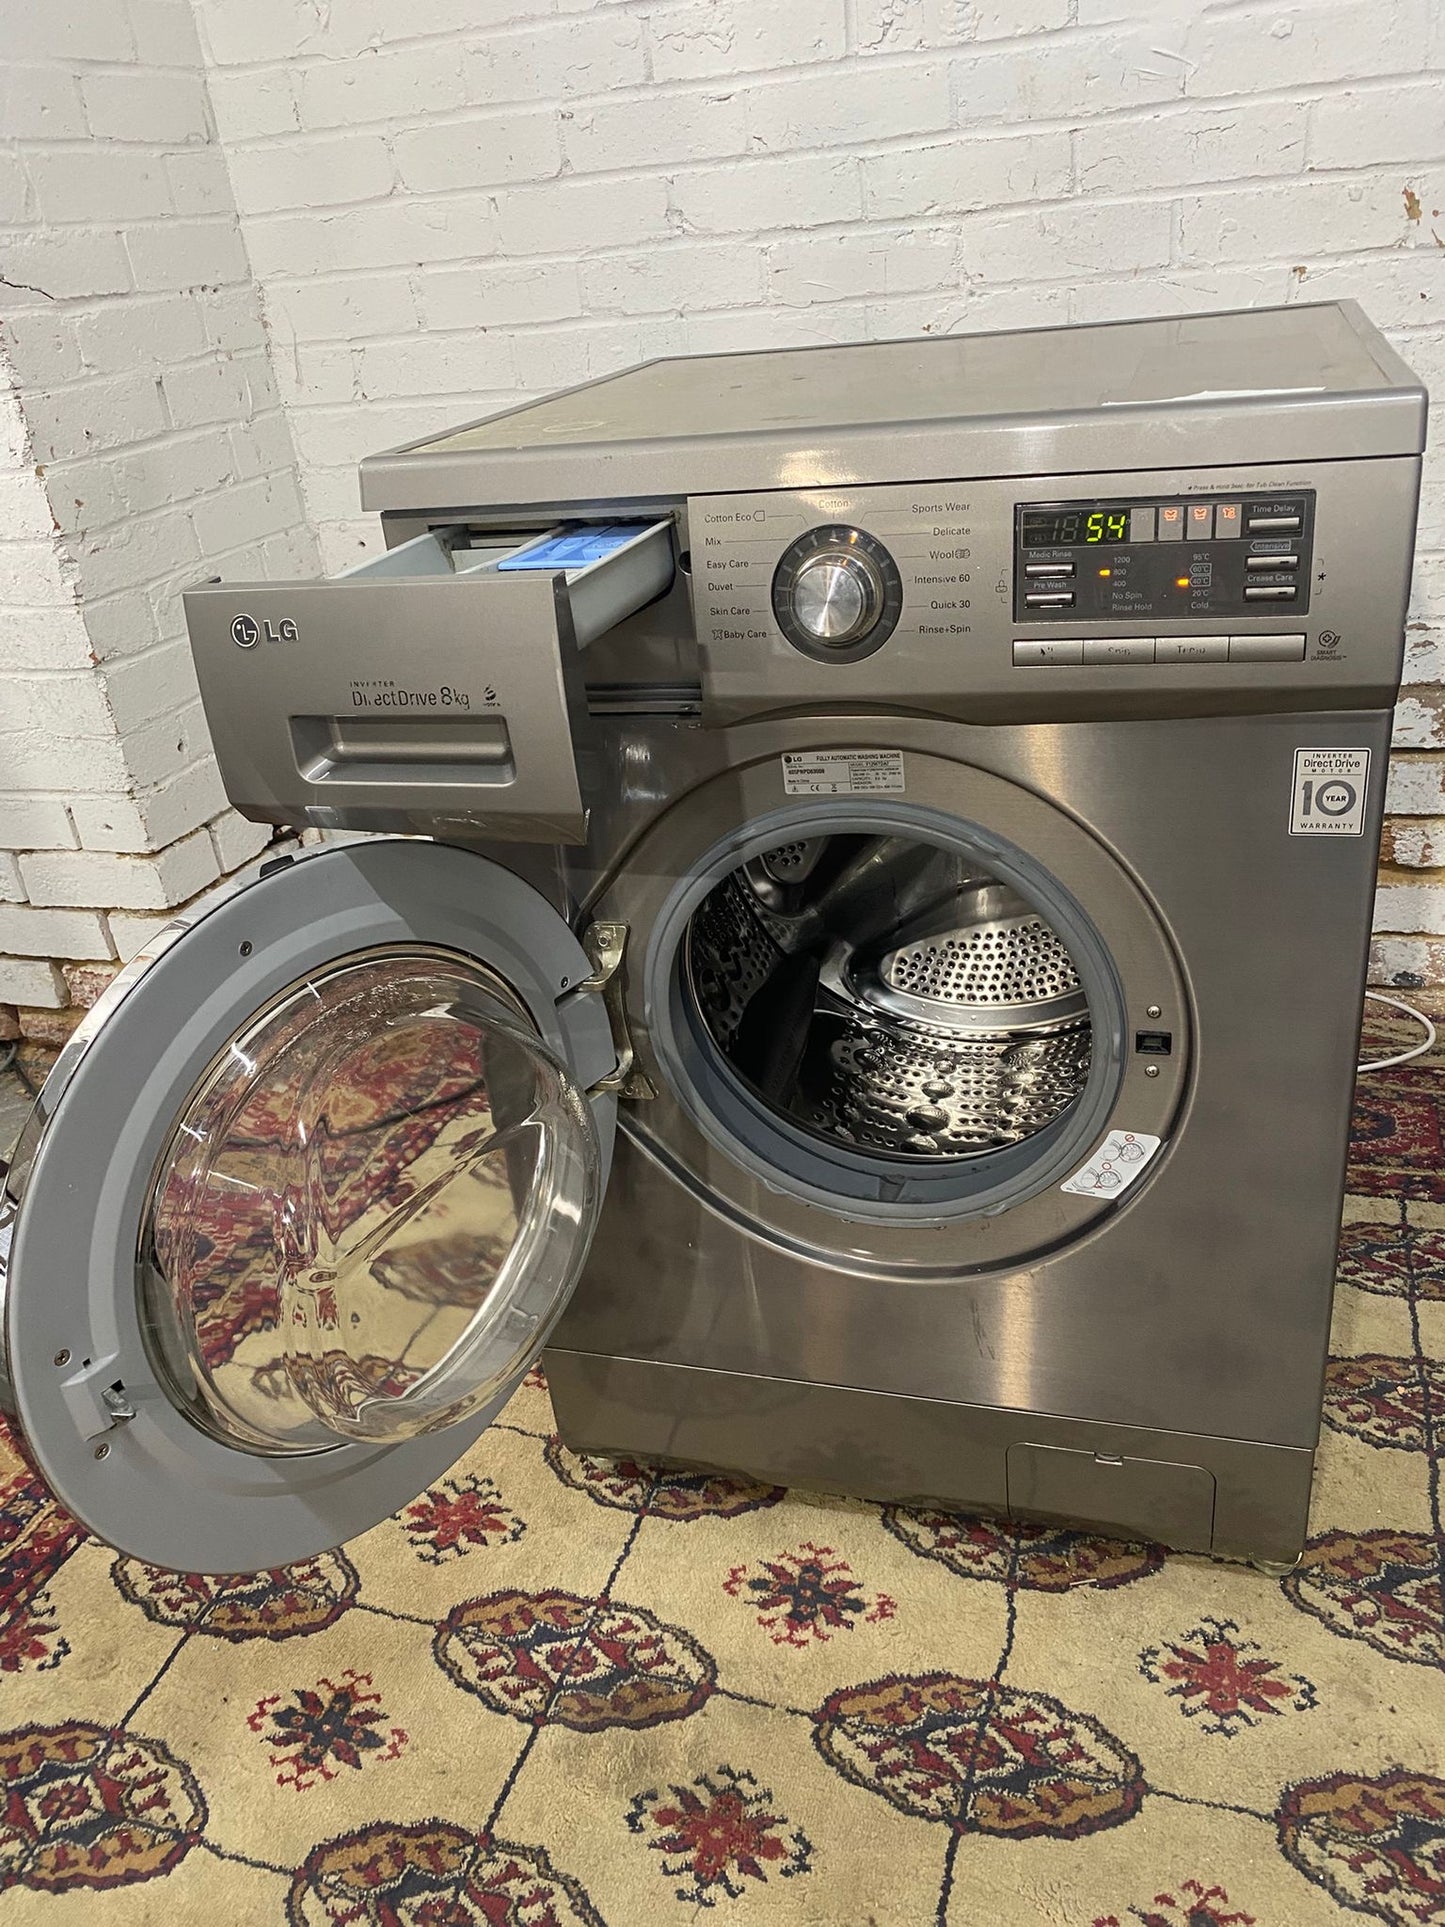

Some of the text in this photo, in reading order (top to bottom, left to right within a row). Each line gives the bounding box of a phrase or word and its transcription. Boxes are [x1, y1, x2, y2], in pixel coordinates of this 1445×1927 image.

[818, 499, 849, 509] Cotton
[911, 502, 971, 514] Sports Wear
[1252, 504, 1296, 513] Time Delay
[704, 512, 752, 524] Cotton Eco
[932, 526, 971, 536] Delicate
[705, 537, 722, 546] Mix
[929, 550, 955, 560] Wool
[1029, 550, 1073, 559] Medic Rinse
[706, 559, 749, 570] Easy Care
[1113, 556, 1131, 564] 1200
[914, 574, 971, 585] Intensive 60
[1247, 573, 1294, 582] Crease Care
[707, 582, 734, 592] Duvet
[1046, 581, 1067, 589] Wash
[1112, 580, 1127, 588] 400
[1112, 591, 1143, 600] No Spin
[930, 600, 971, 610] Quick 30
[1112, 602, 1153, 611] Rinse Hold
[1191, 601, 1209, 609] Cold
[710, 606, 751, 616] Skin Care
[263, 617, 299, 643] LG
[723, 629, 767, 640] Baby Care
[918, 624, 972, 635] Rinse+Spin
[1303, 758, 1361, 768] Direct Drive
[1301, 779, 1357, 817] 10
[1300, 822, 1354, 830] WARRANTY
